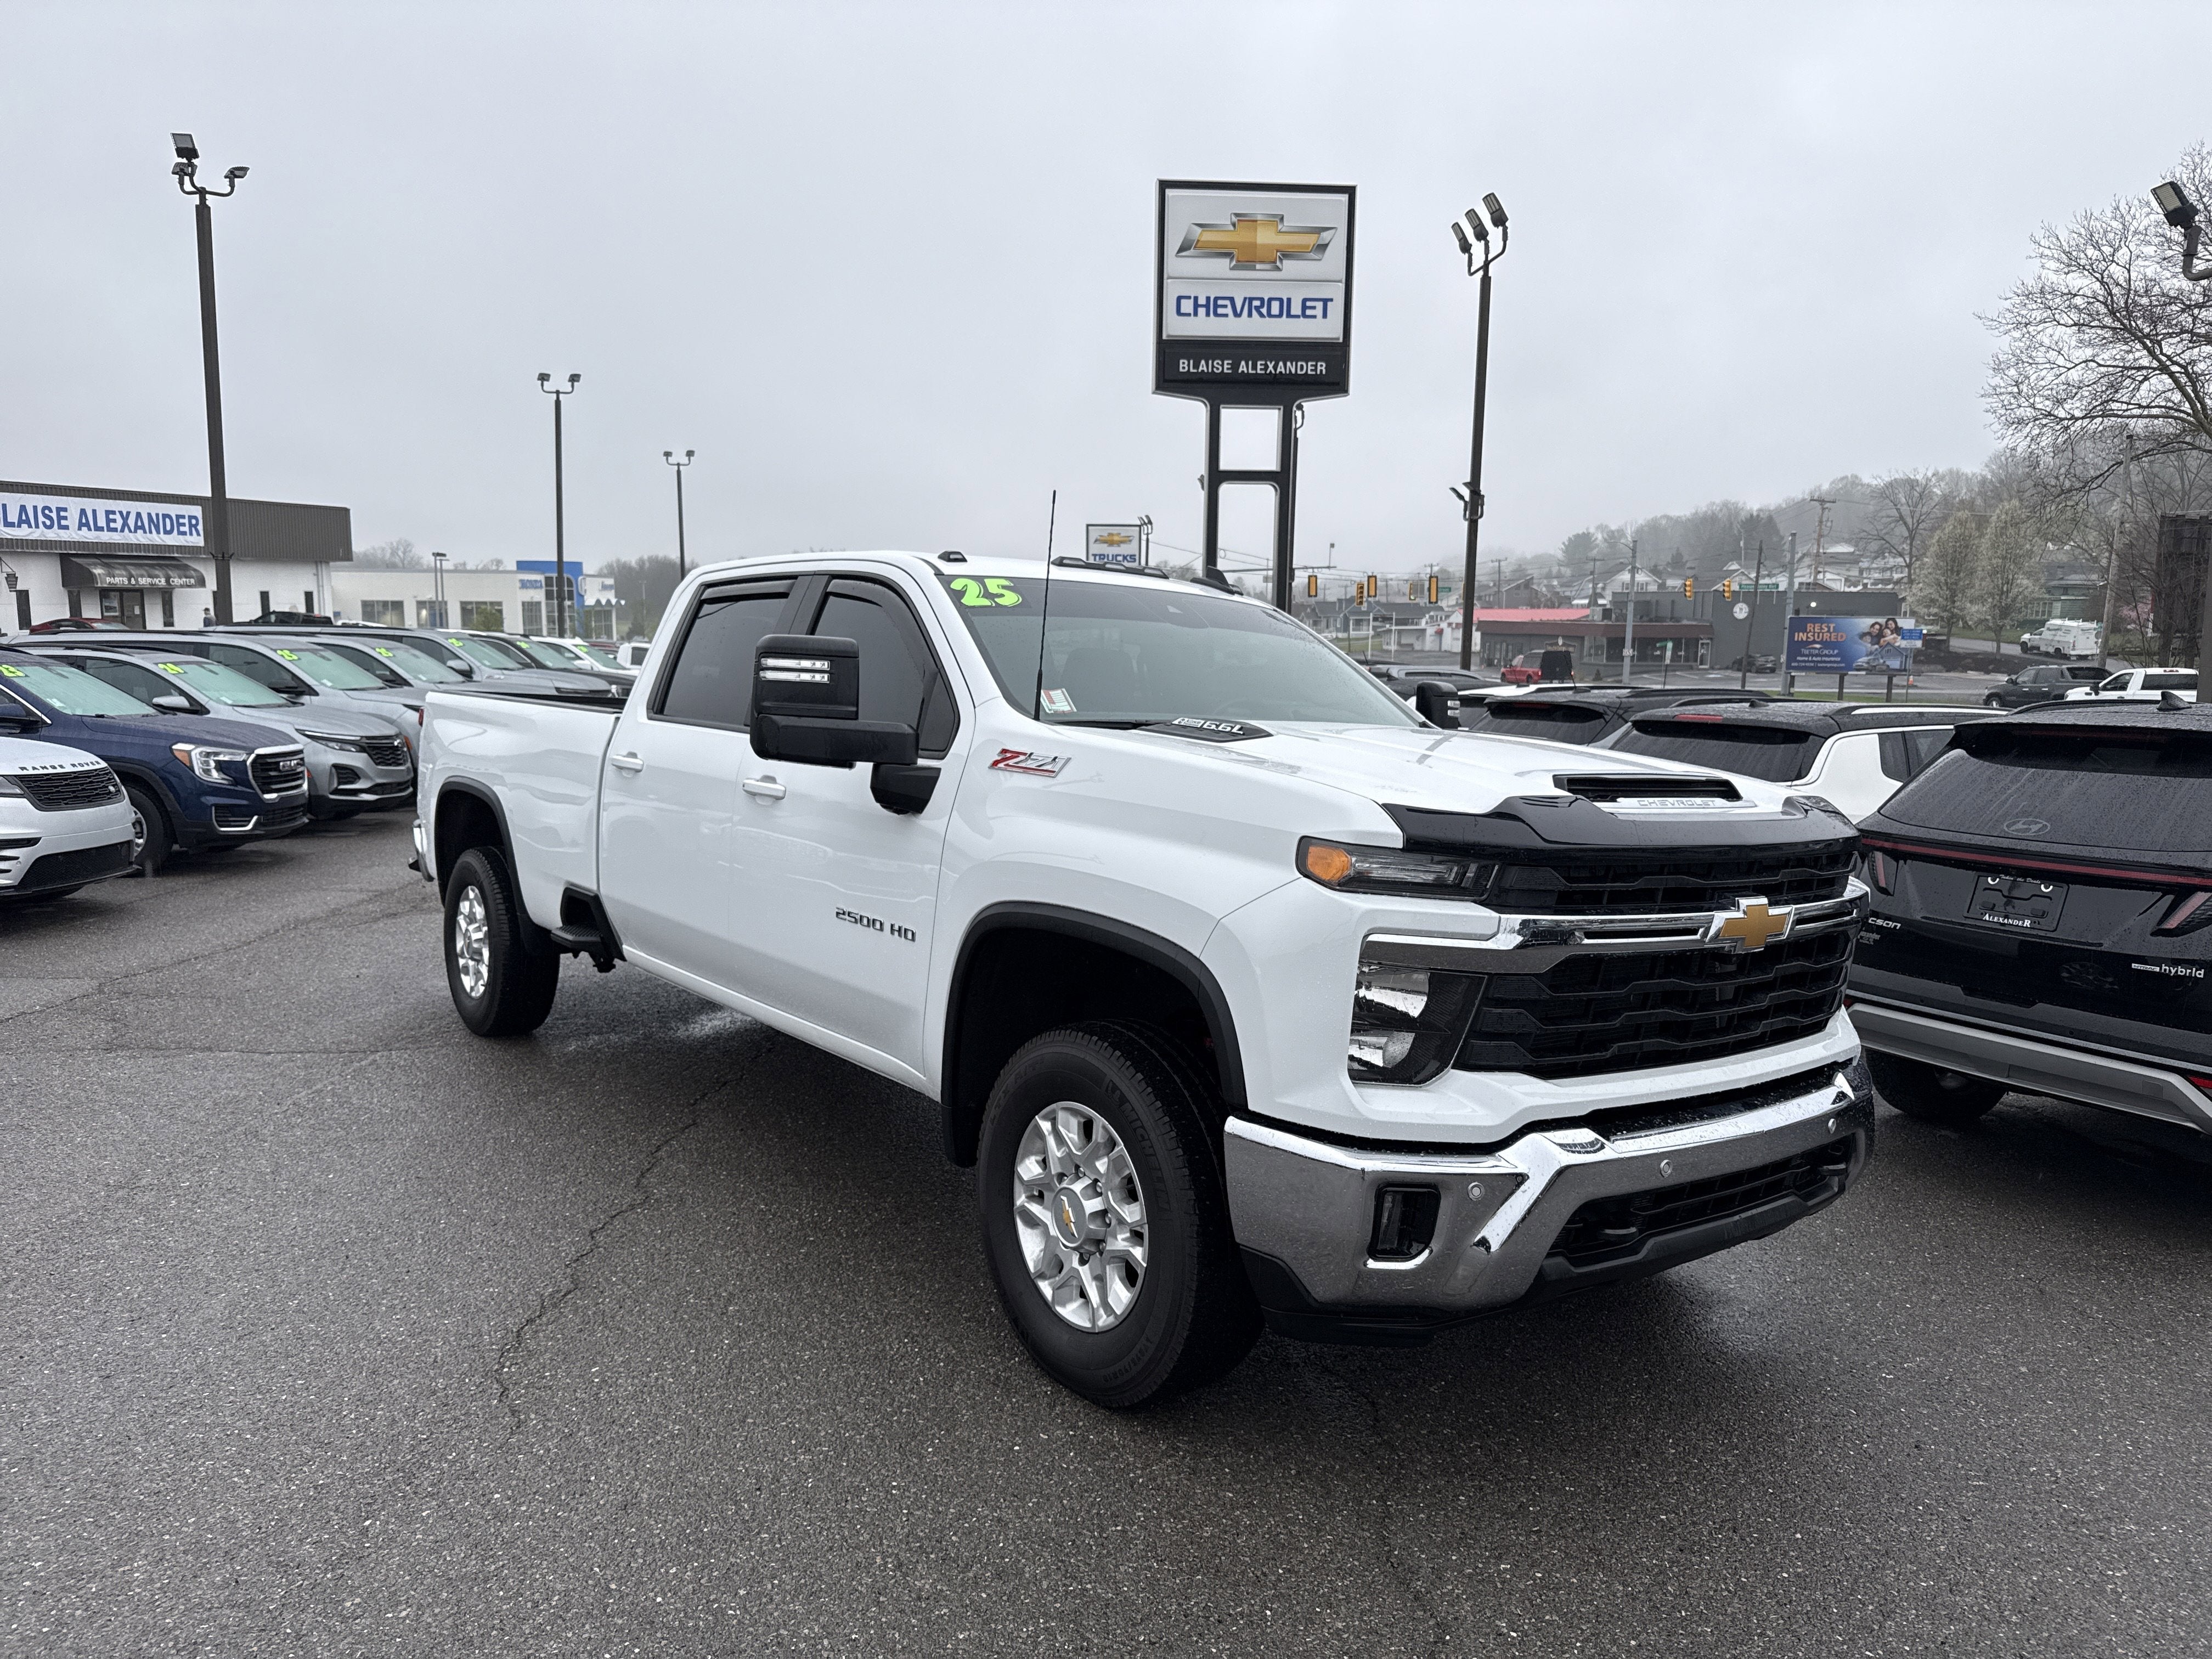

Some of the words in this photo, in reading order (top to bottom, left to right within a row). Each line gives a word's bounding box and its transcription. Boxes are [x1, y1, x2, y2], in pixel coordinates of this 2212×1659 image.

[1176, 295, 1334, 319] CHEVROLET
[1179, 359, 1232, 374] BLAISE
[1238, 360, 1327, 375] ALEXANDER
[0, 503, 70, 531] LAISE
[77, 508, 201, 537] ALEXANDER
[1092, 554, 1137, 563] TRUCKS
[106, 577, 128, 585] PARTS
[138, 577, 166, 585] SERVICE
[950, 578, 1023, 607] 25
[1806, 623, 1836, 633] REST
[1794, 632, 1847, 641] INSURED
[70, 760, 101, 768] ROVER
[988, 748, 1072, 778] Z71
[836, 907, 885, 932] 2500
[890, 922, 917, 943] HD
[2162, 963, 2205, 978] hybrid
[1119, 1103, 1172, 1211] MICHELIN
